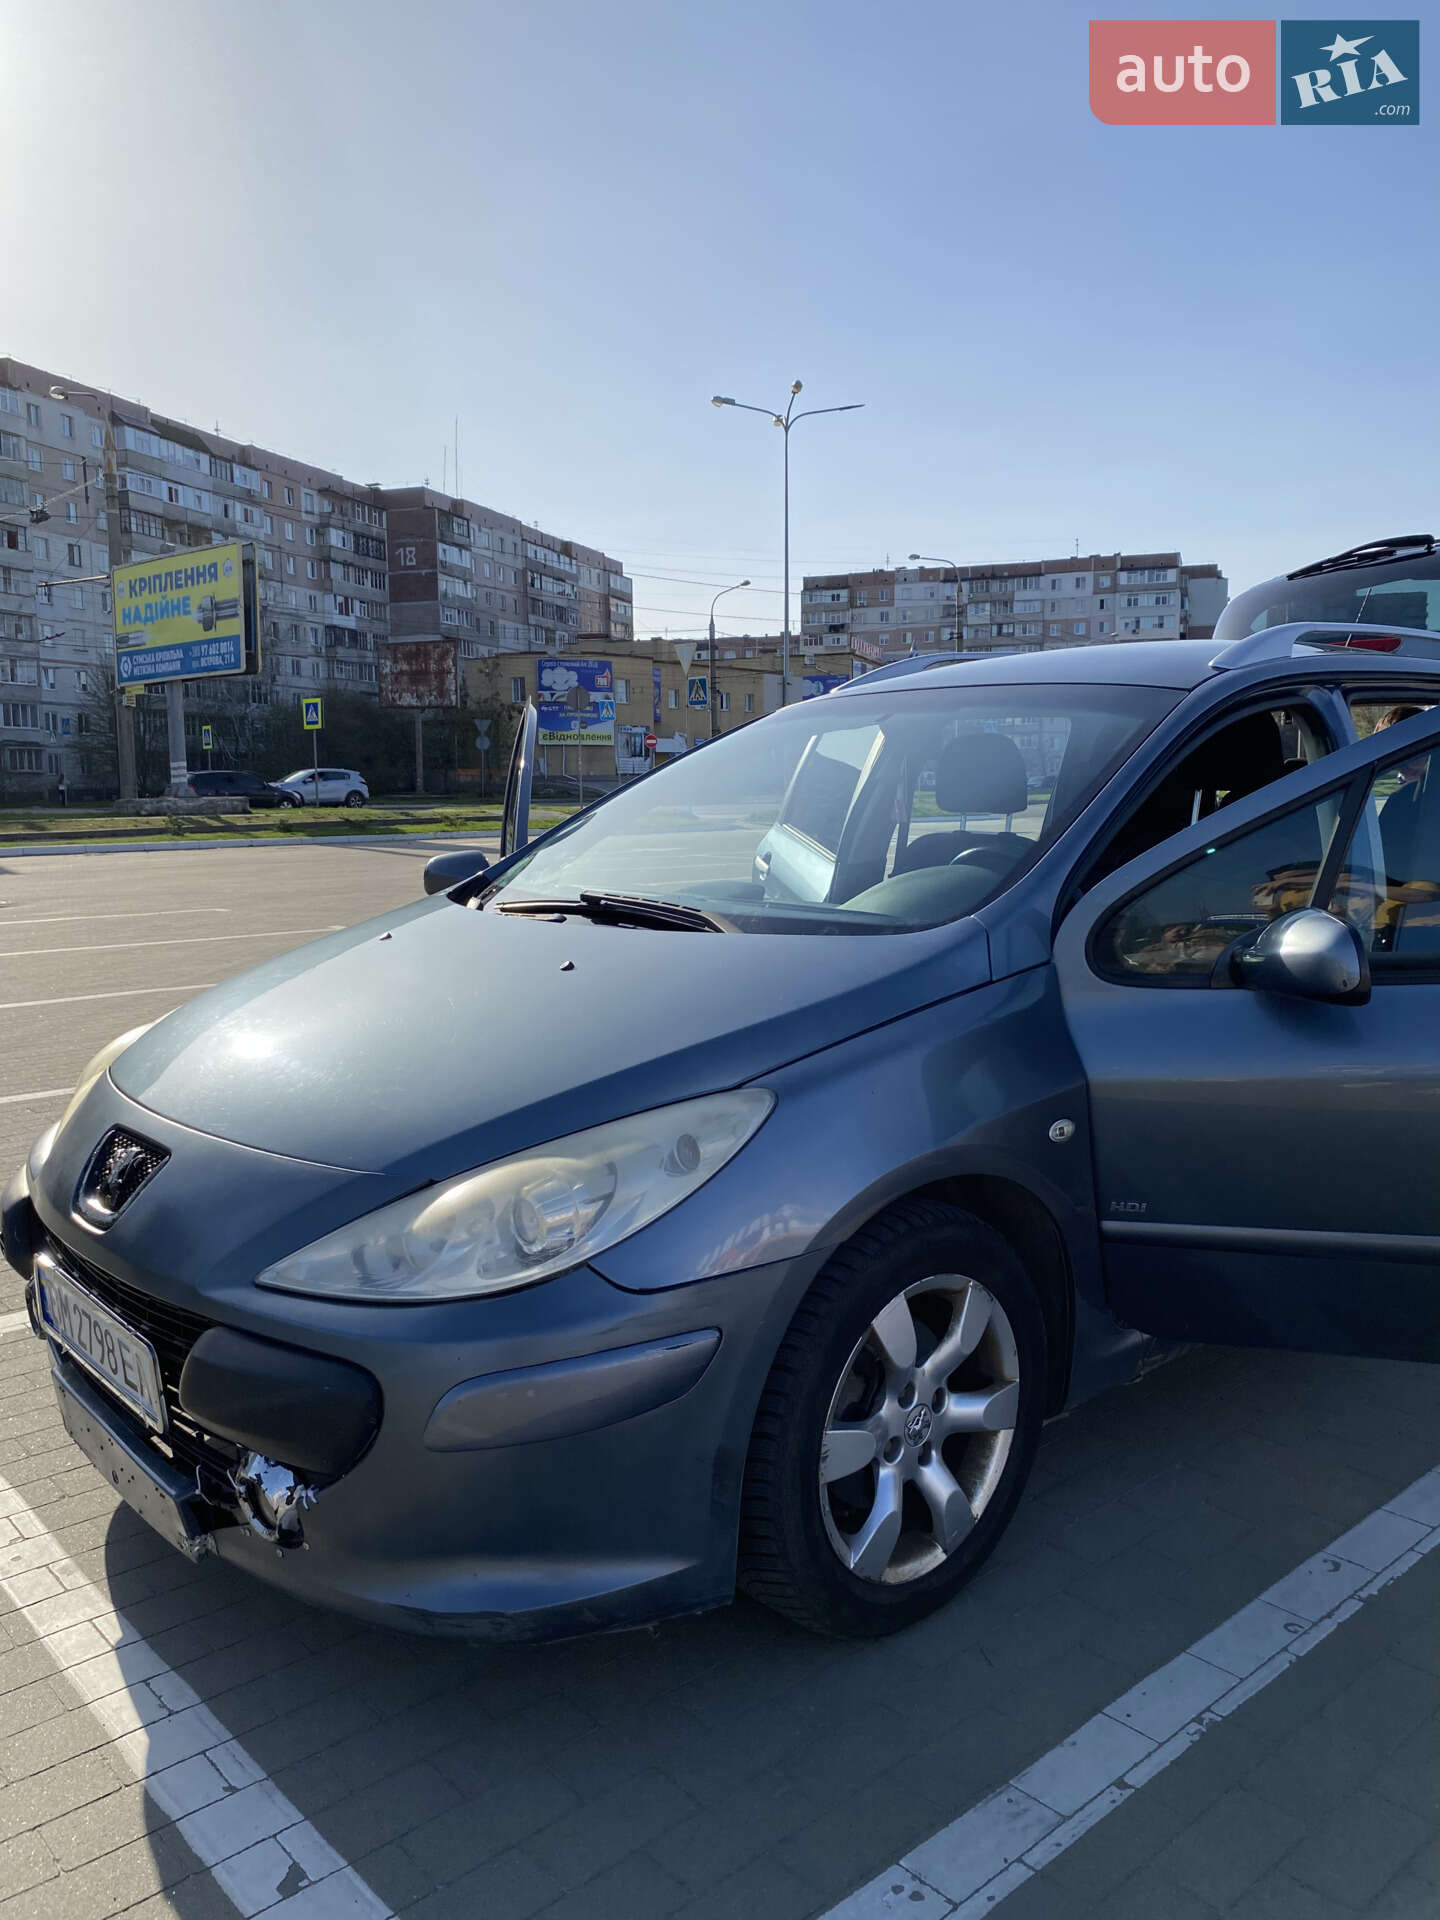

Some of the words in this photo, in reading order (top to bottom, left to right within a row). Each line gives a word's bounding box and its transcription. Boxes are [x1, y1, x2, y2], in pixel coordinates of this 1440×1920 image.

[128, 561, 219, 599] КРІПЛЕННЯ
[122, 594, 192, 627] НАДІЙНЕ
[1109, 1201, 1148, 1213] HDI
